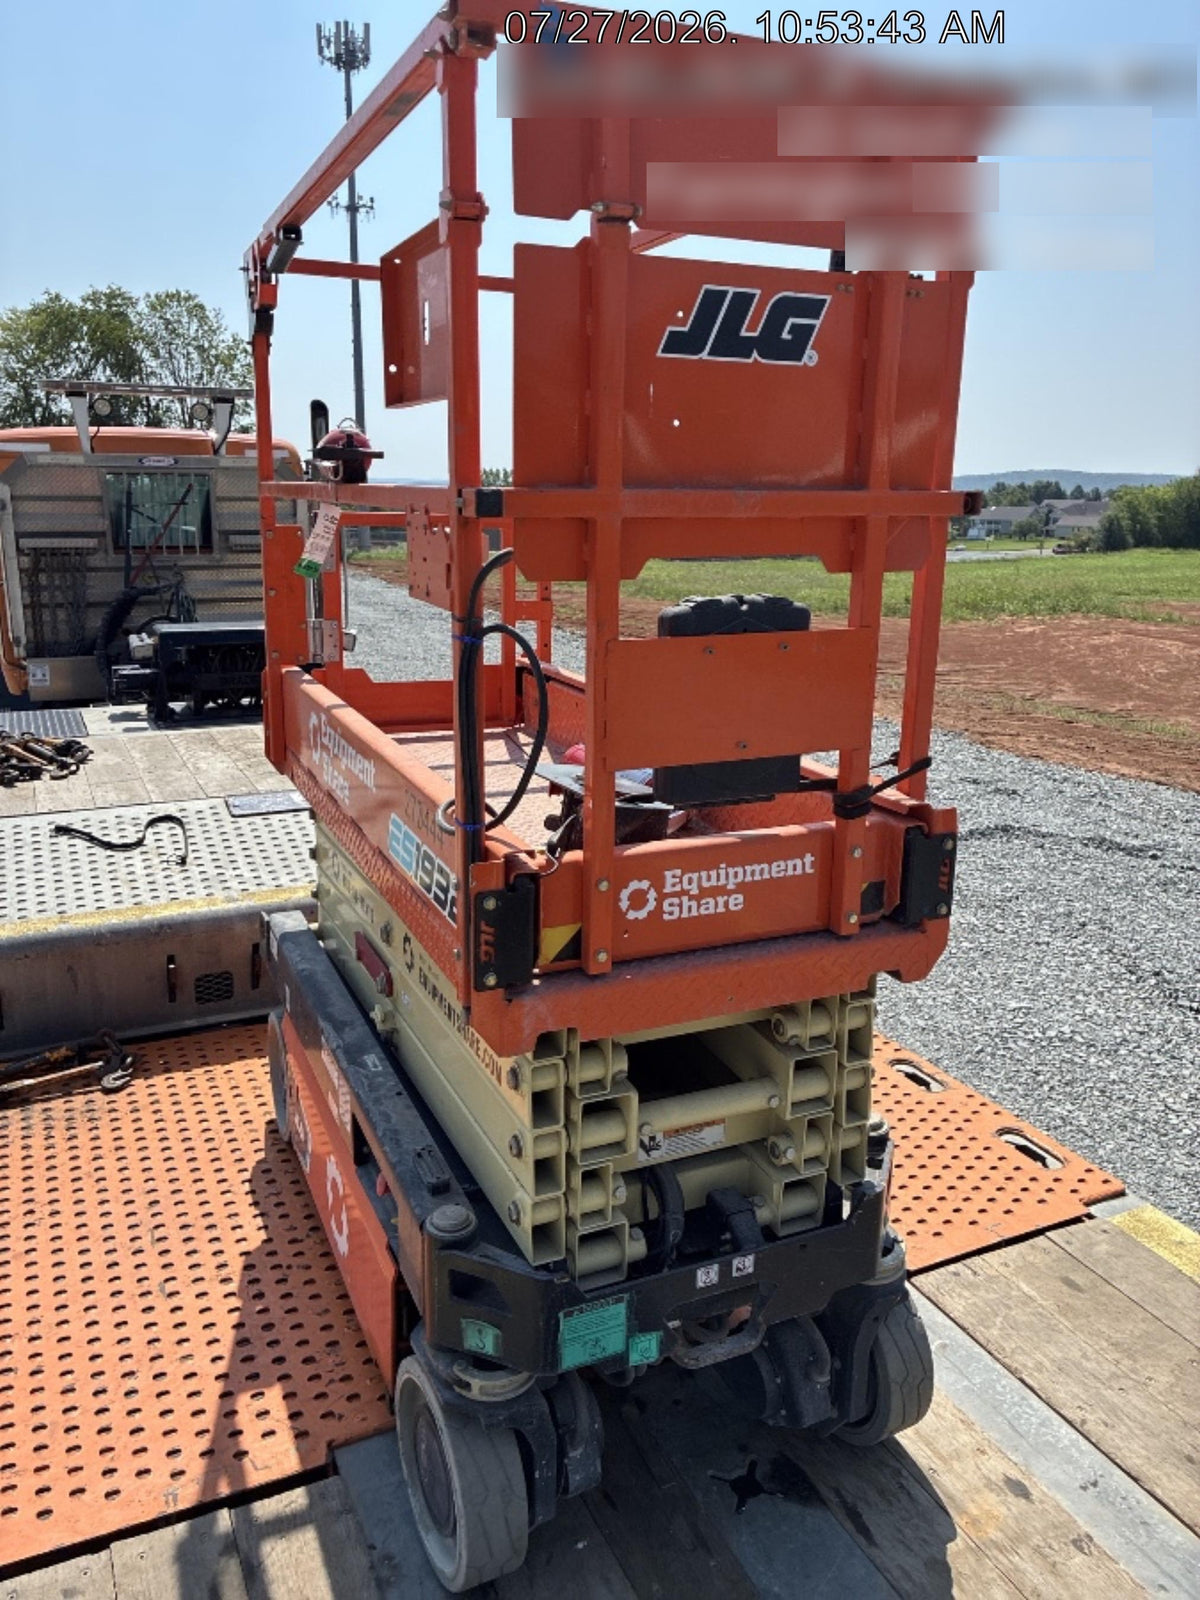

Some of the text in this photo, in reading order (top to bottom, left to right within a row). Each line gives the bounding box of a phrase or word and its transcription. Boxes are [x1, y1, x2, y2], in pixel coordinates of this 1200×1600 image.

[320, 713, 377, 793] Equipment
[663, 853, 815, 895] Equipment
[662, 893, 744, 921] Share
